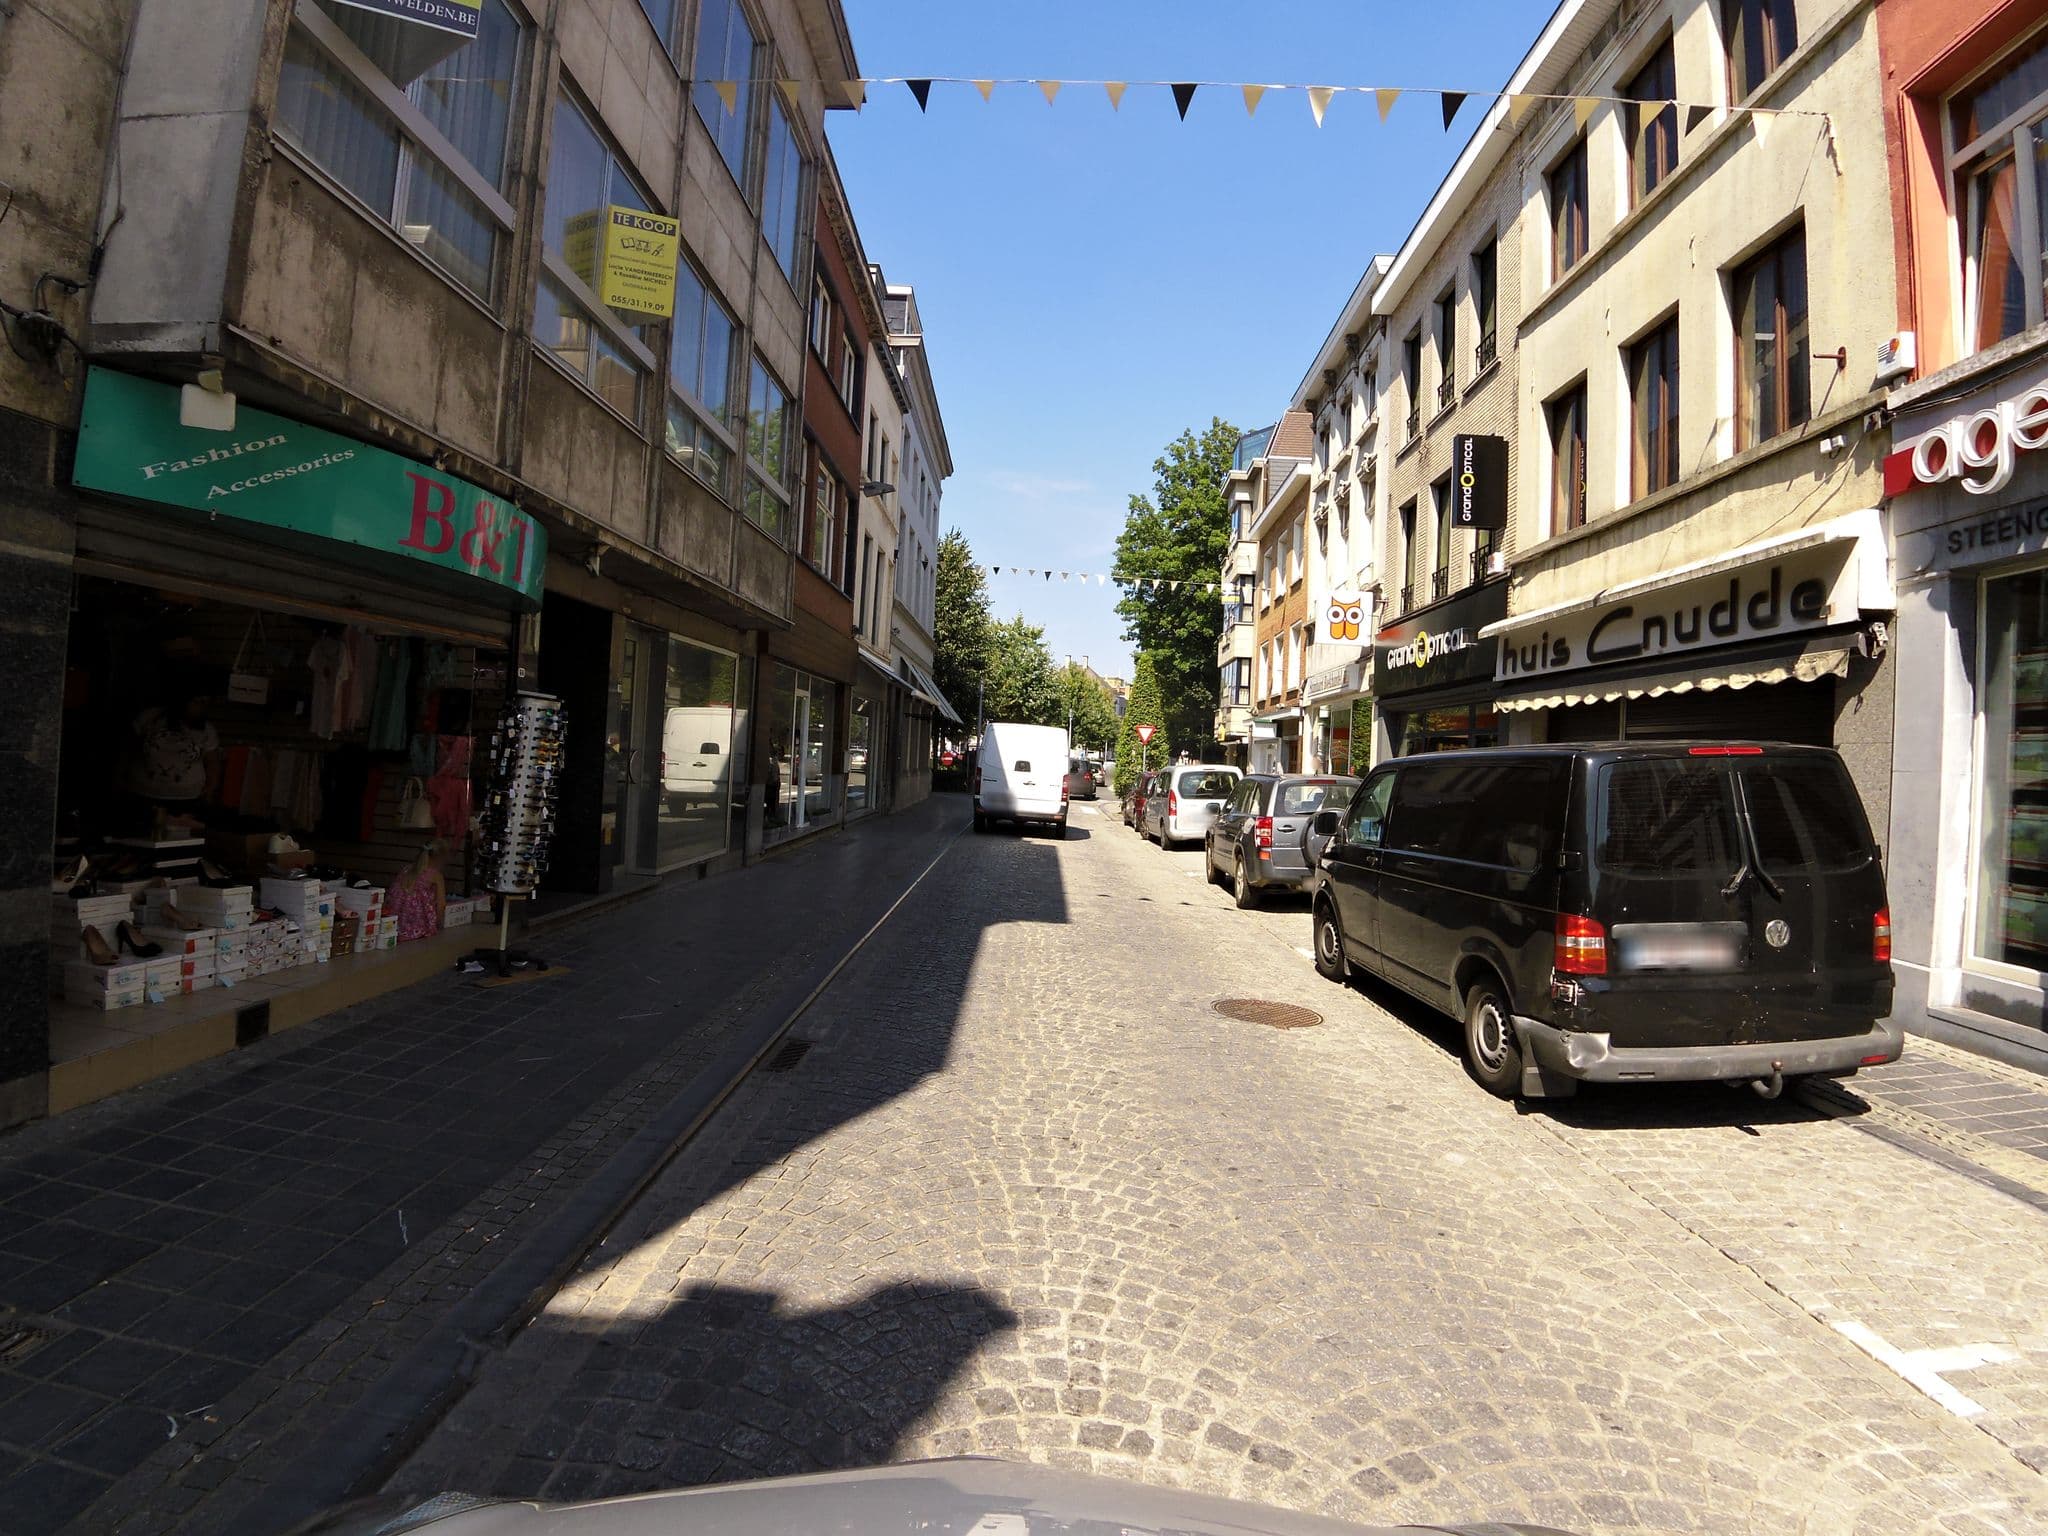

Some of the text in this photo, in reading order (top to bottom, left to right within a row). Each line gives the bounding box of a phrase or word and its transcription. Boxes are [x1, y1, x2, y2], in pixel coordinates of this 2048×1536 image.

[616, 213, 674, 233] TE KOOP
[611, 294, 665, 312] 055/31.19.09
[139, 433, 288, 480] Fashion
[207, 449, 356, 499] Accessories
[1502, 566, 1827, 676] huis Cnudde
